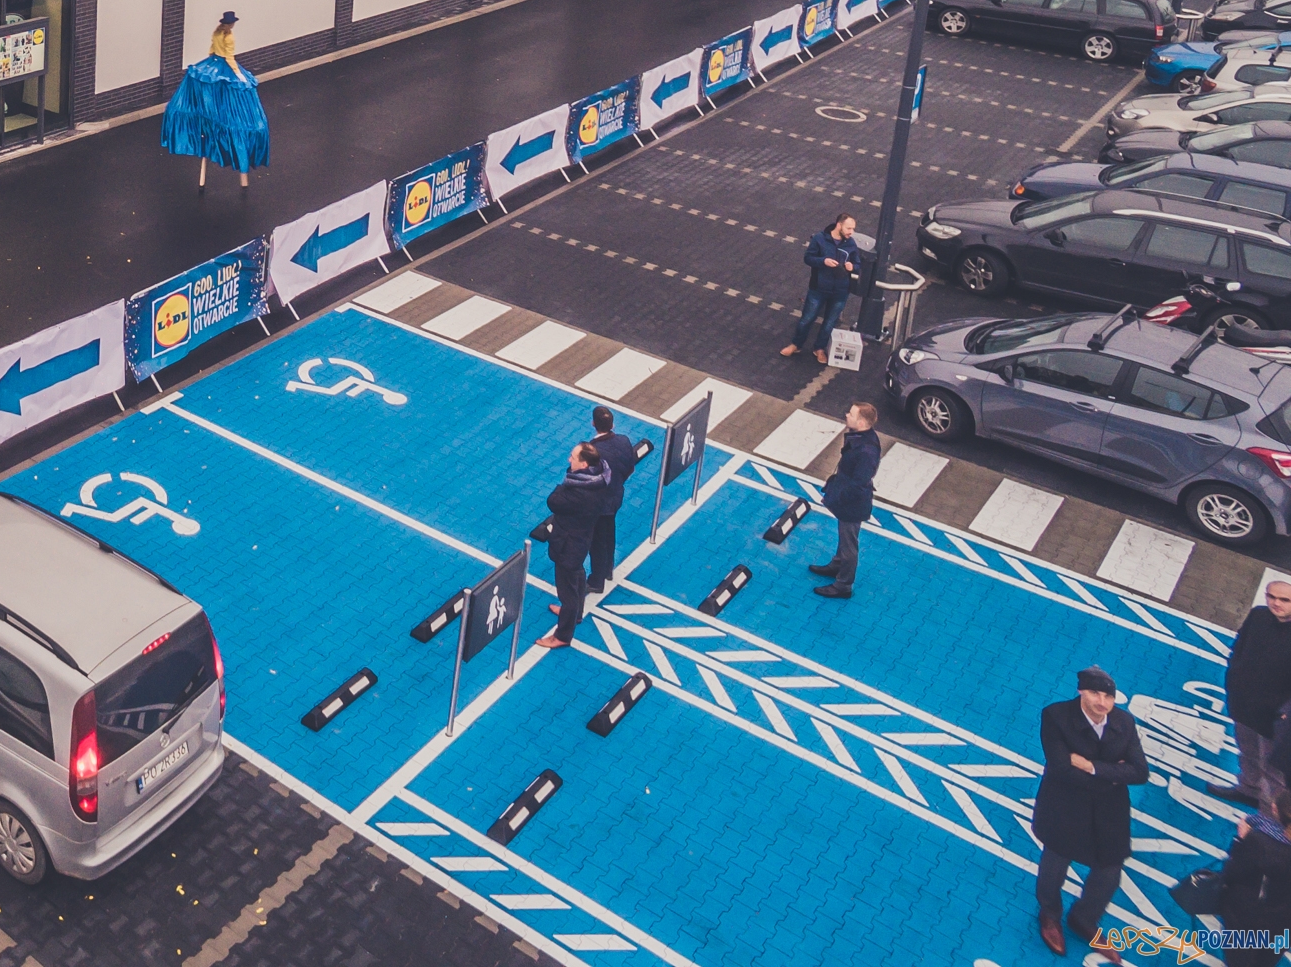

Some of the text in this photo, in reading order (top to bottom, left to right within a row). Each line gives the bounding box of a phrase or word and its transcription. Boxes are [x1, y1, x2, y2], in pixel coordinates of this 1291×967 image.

[451, 159, 470, 178] LIDL!
[435, 173, 467, 202] WIELKIE
[432, 191, 466, 218] OTWARCIE
[193, 259, 243, 296] 600. LIDL!
[192, 277, 240, 316] WIELKIE
[193, 296, 239, 335] OTWARCIE
